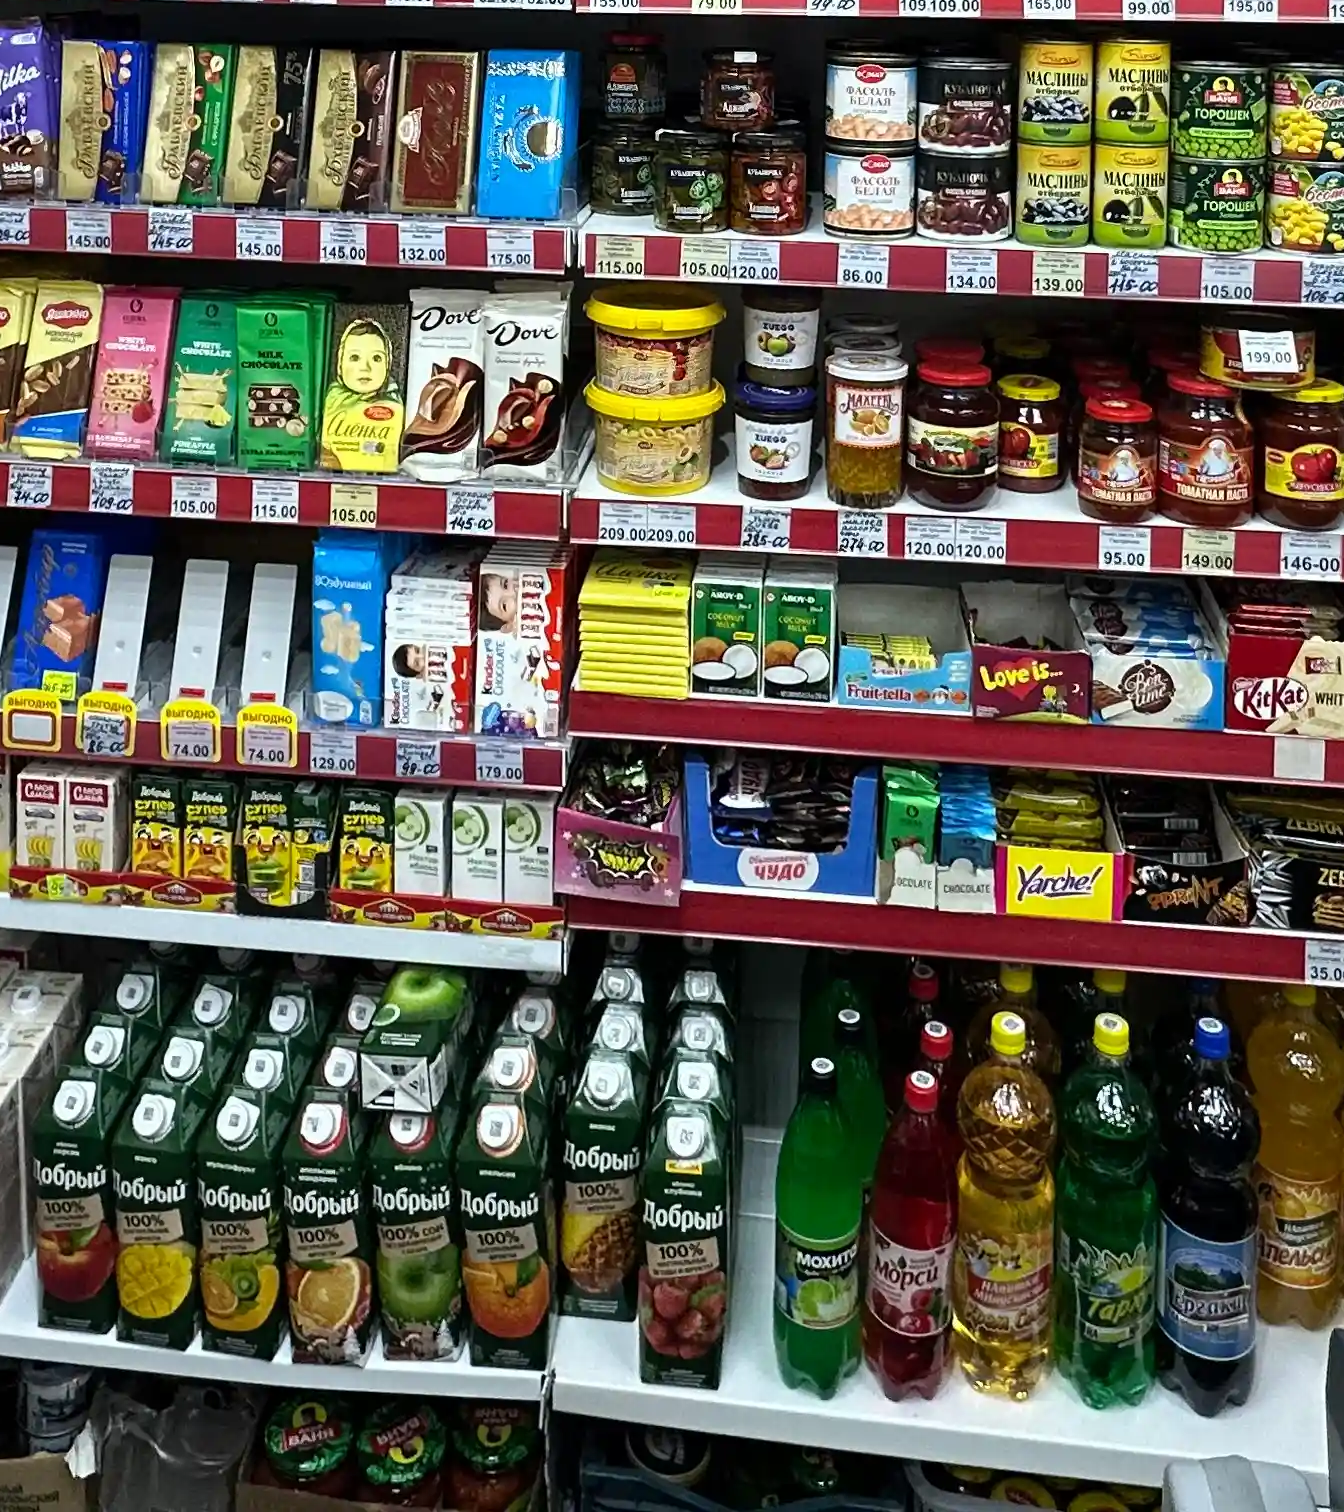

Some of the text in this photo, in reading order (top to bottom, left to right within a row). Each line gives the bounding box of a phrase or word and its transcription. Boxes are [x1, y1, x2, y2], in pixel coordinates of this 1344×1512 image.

[1025, 68, 1089, 87] МАСЛИНЫ
[846, 86, 897, 99] ФАСОЛЬ
[849, 96, 892, 107] БЕЛАЯ
[164, 61, 189, 180] БАБАЕВСКИЙ
[1194, 108, 1251, 122] ГОРОШЕК
[400, 247, 446, 262] 132.00
[843, 268, 883, 284] 86.00
[414, 306, 483, 330] Dove
[257, 351, 284, 360] MILK
[240, 360, 303, 371] CHOCOLATE
[710, 590, 744, 601] AROY-D
[979, 664, 1027, 691] Love
[846, 684, 912, 703] Fruit-tella
[1241, 682, 1305, 720] KitKat
[165, 709, 216, 720] ВЫГОДНО
[173, 744, 209, 758] 74.00
[753, 864, 806, 882] ЧУДО
[1017, 864, 1104, 901] Yarche!
[372, 1184, 451, 1215] Добрый
[643, 1200, 724, 1234] Добрый
[381, 1225, 419, 1241] 100%
